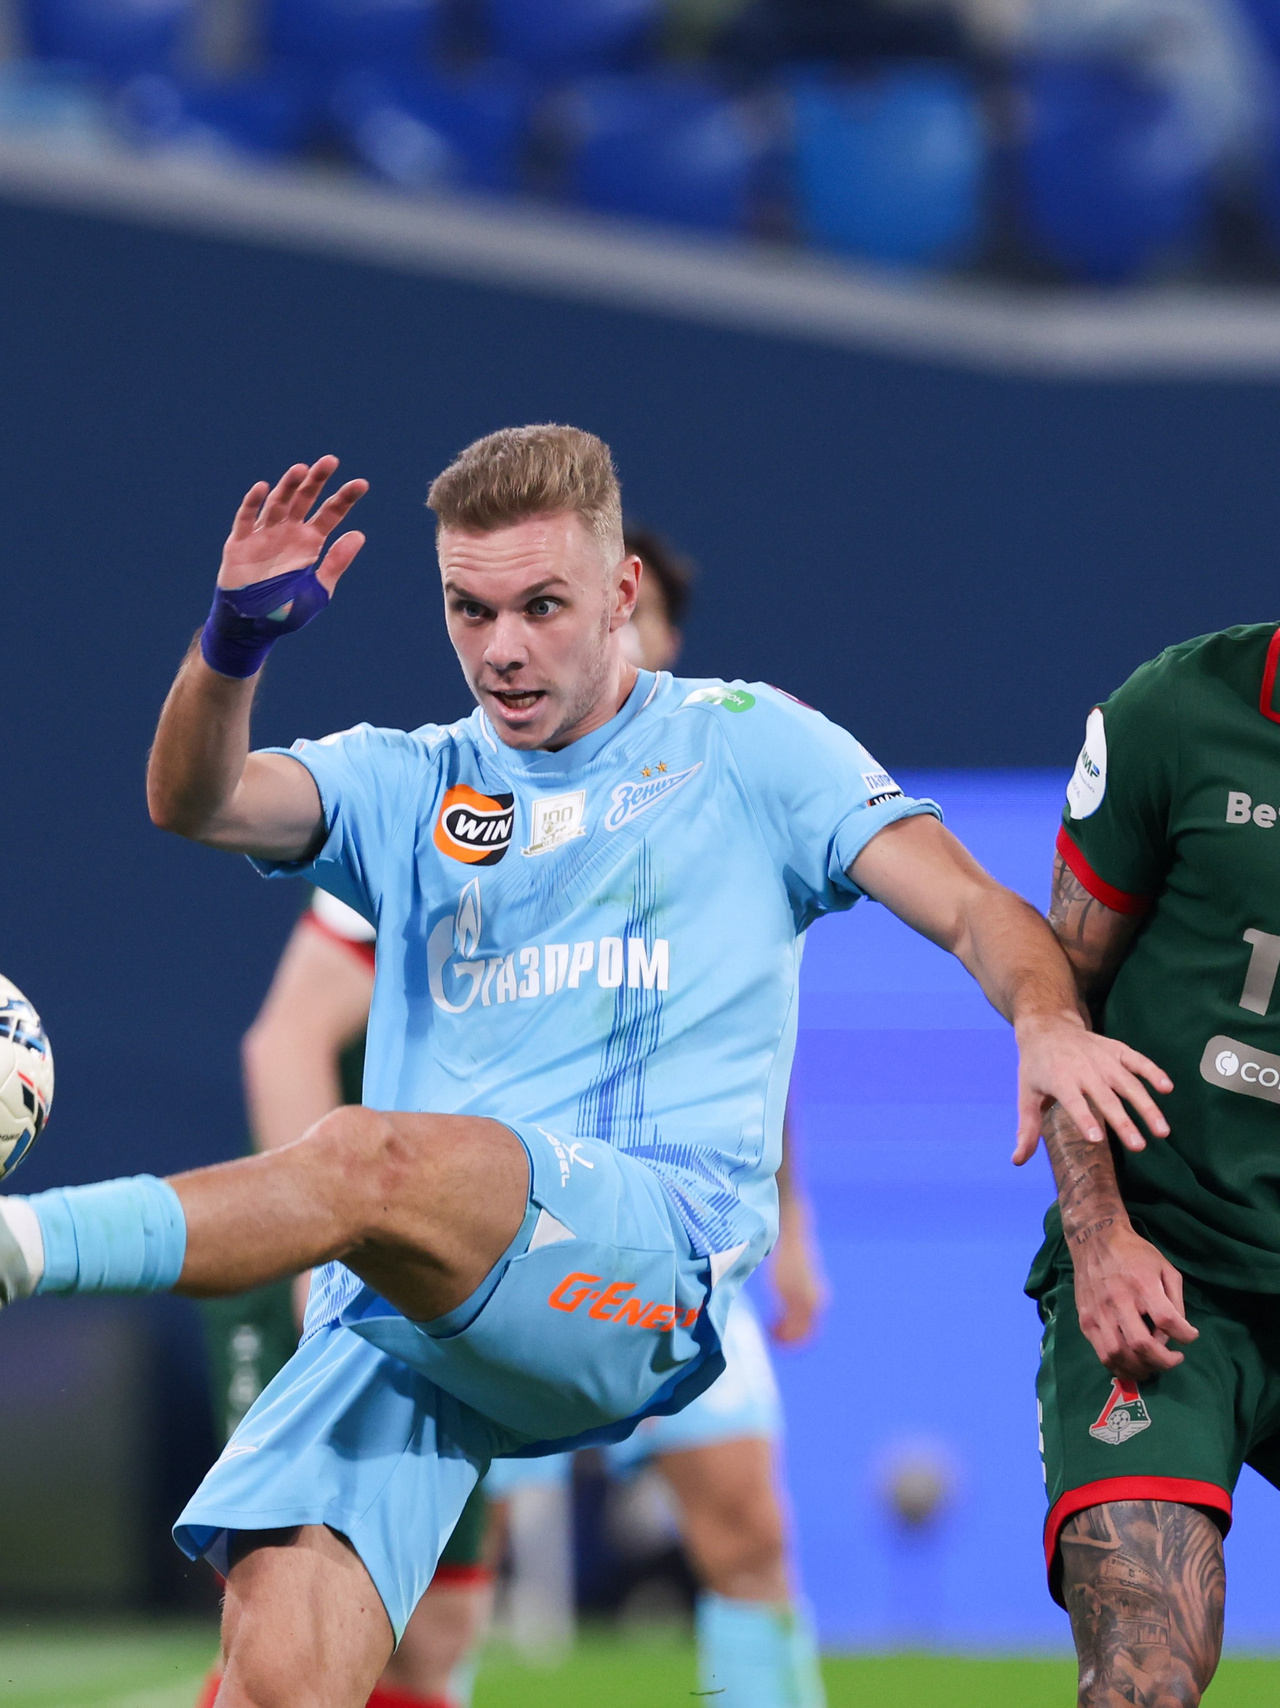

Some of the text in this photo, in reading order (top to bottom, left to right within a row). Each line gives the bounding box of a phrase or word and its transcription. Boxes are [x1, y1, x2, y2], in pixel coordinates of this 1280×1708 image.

[1225, 791, 1280, 829] Be
[481, 937, 670, 1008] ГАЗПРОМ
[1240, 1062, 1280, 1090] CO
